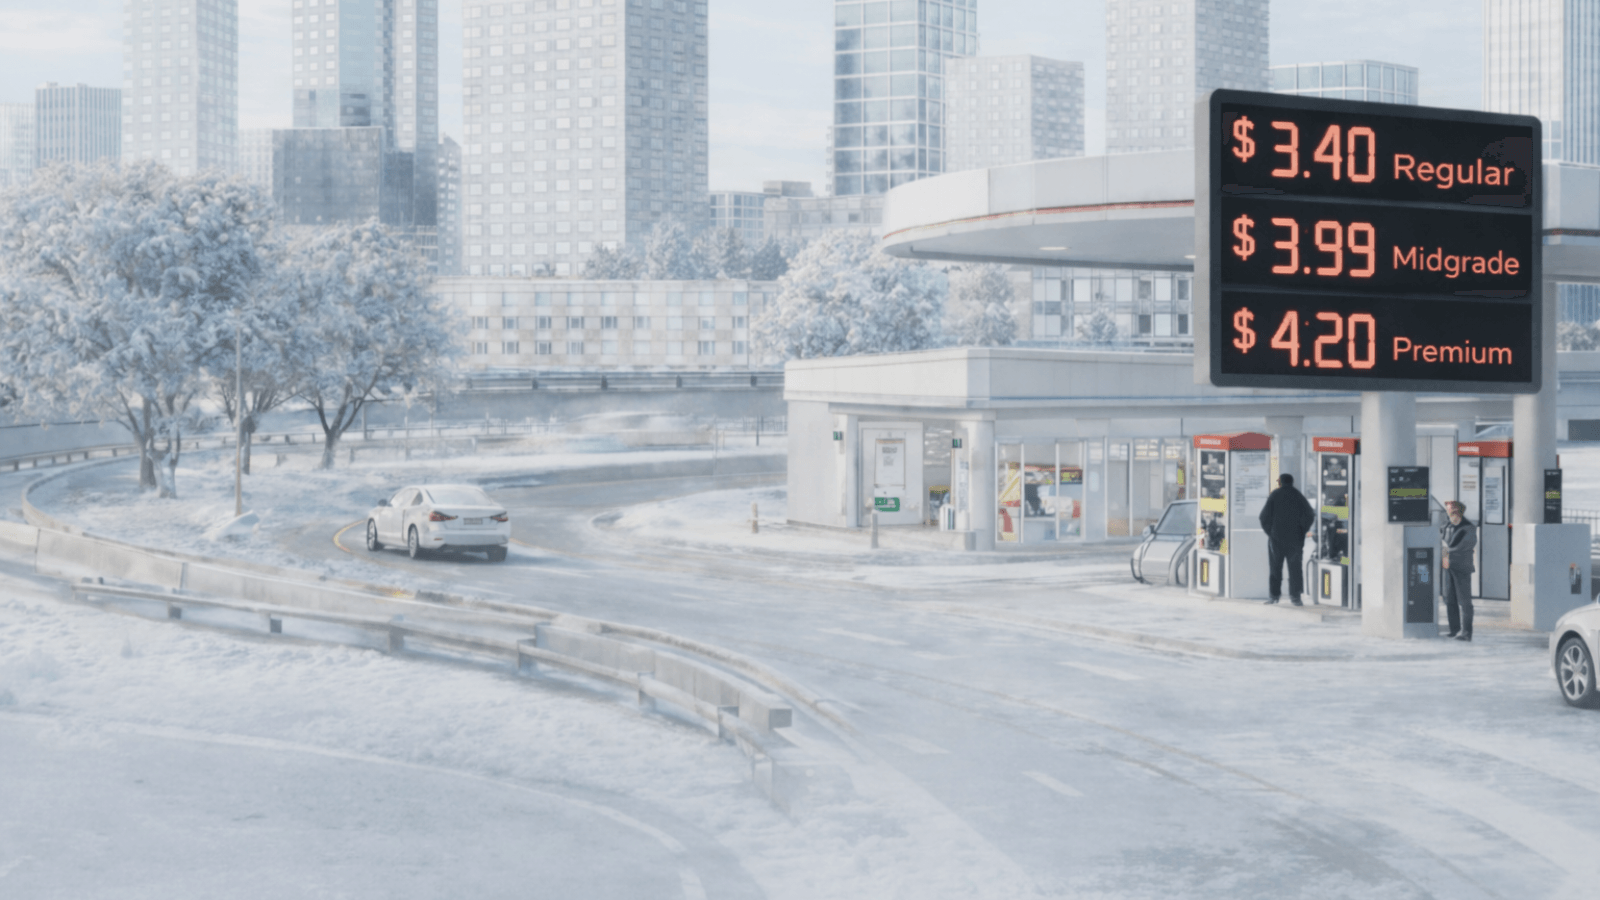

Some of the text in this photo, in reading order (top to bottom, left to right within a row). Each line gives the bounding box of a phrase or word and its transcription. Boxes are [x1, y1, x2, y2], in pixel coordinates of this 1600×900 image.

[1271, 121, 1375, 183] 3.40
[1394, 154, 1514, 189] Regular
[1271, 218, 1375, 277] 3.99
[1394, 246, 1519, 278] Midgrade
[1271, 311, 1375, 369] 4.20
[1394, 337, 1512, 364] Premium
